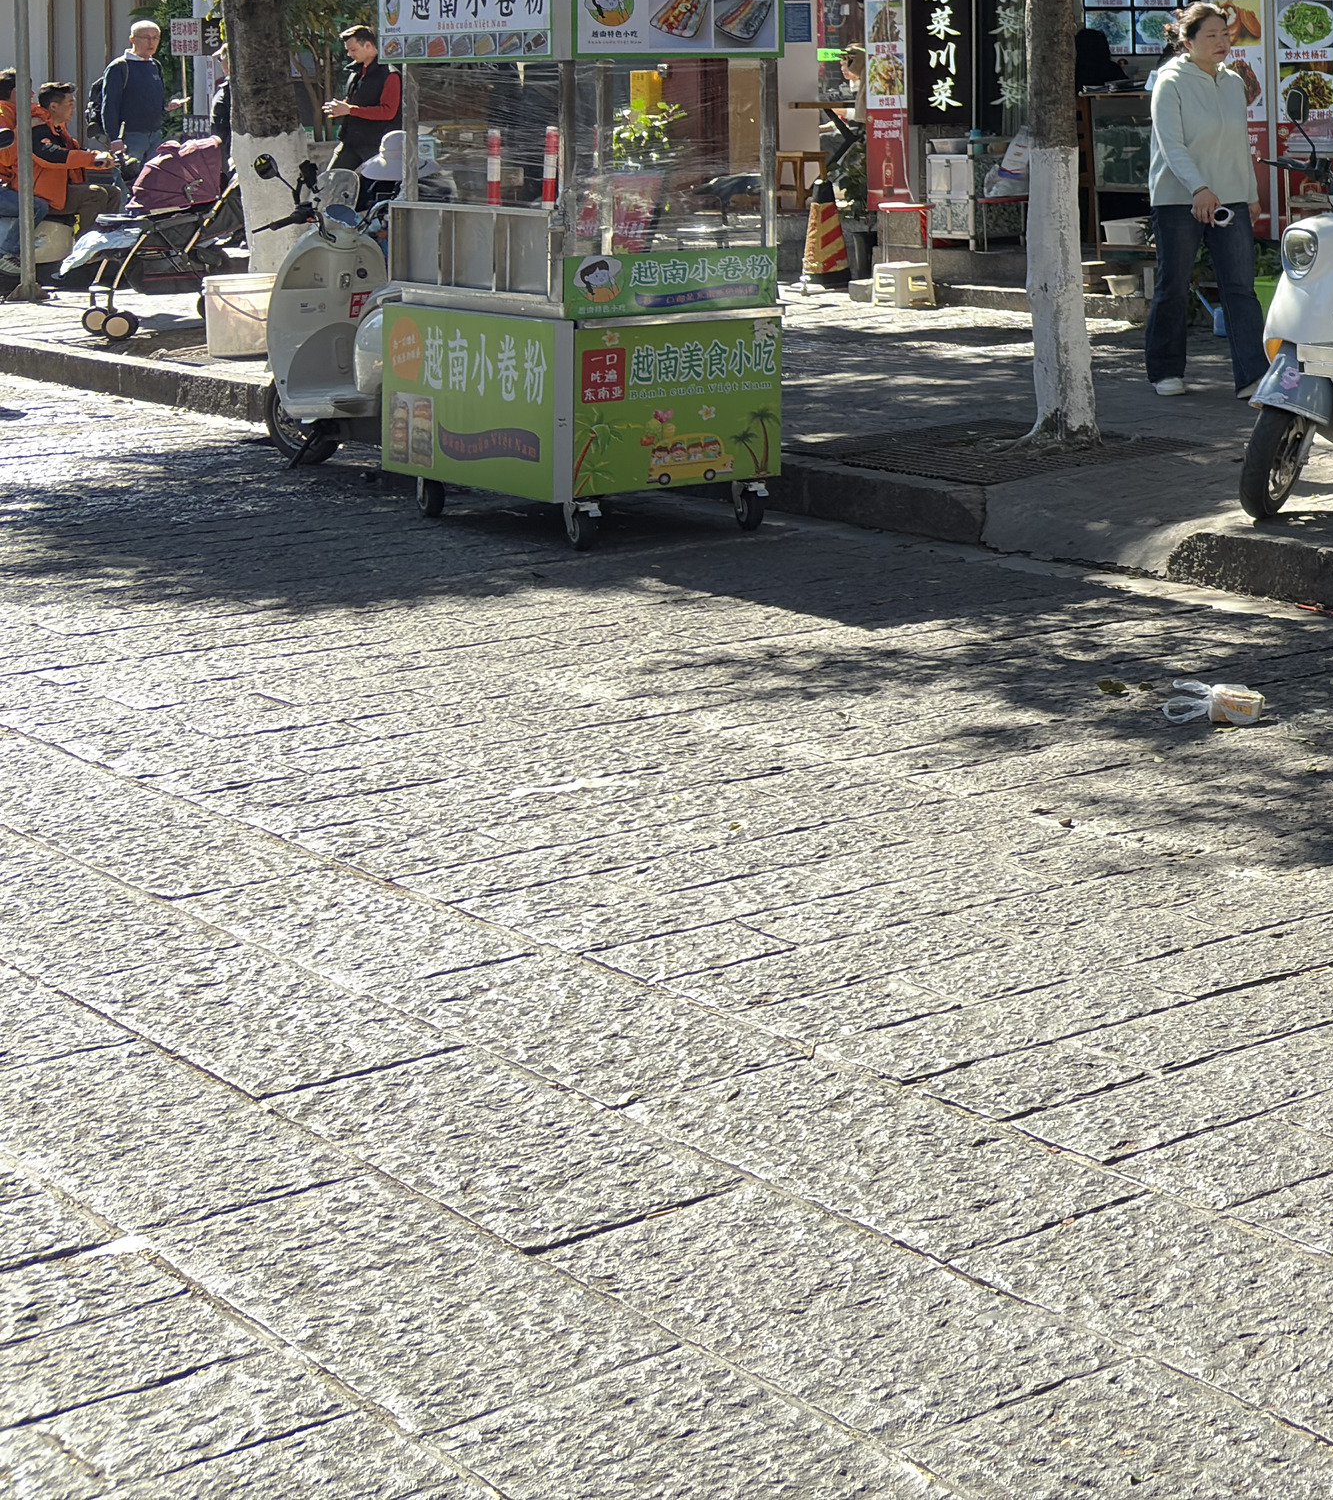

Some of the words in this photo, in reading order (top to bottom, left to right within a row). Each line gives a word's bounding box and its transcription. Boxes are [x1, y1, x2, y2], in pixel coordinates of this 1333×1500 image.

[491, 20, 507, 29] Nam
[629, 254, 774, 287] 越南小卷粉
[423, 325, 547, 405] 越南小卷粉
[590, 353, 618, 365] 一口
[629, 339, 776, 386] 越南美食小吃
[590, 370, 618, 383] 吃遍
[583, 386, 624, 401] 东南亚
[629, 386, 667, 399] Bánh
[708, 381, 739, 396] Việt
[742, 381, 773, 391] Nam
